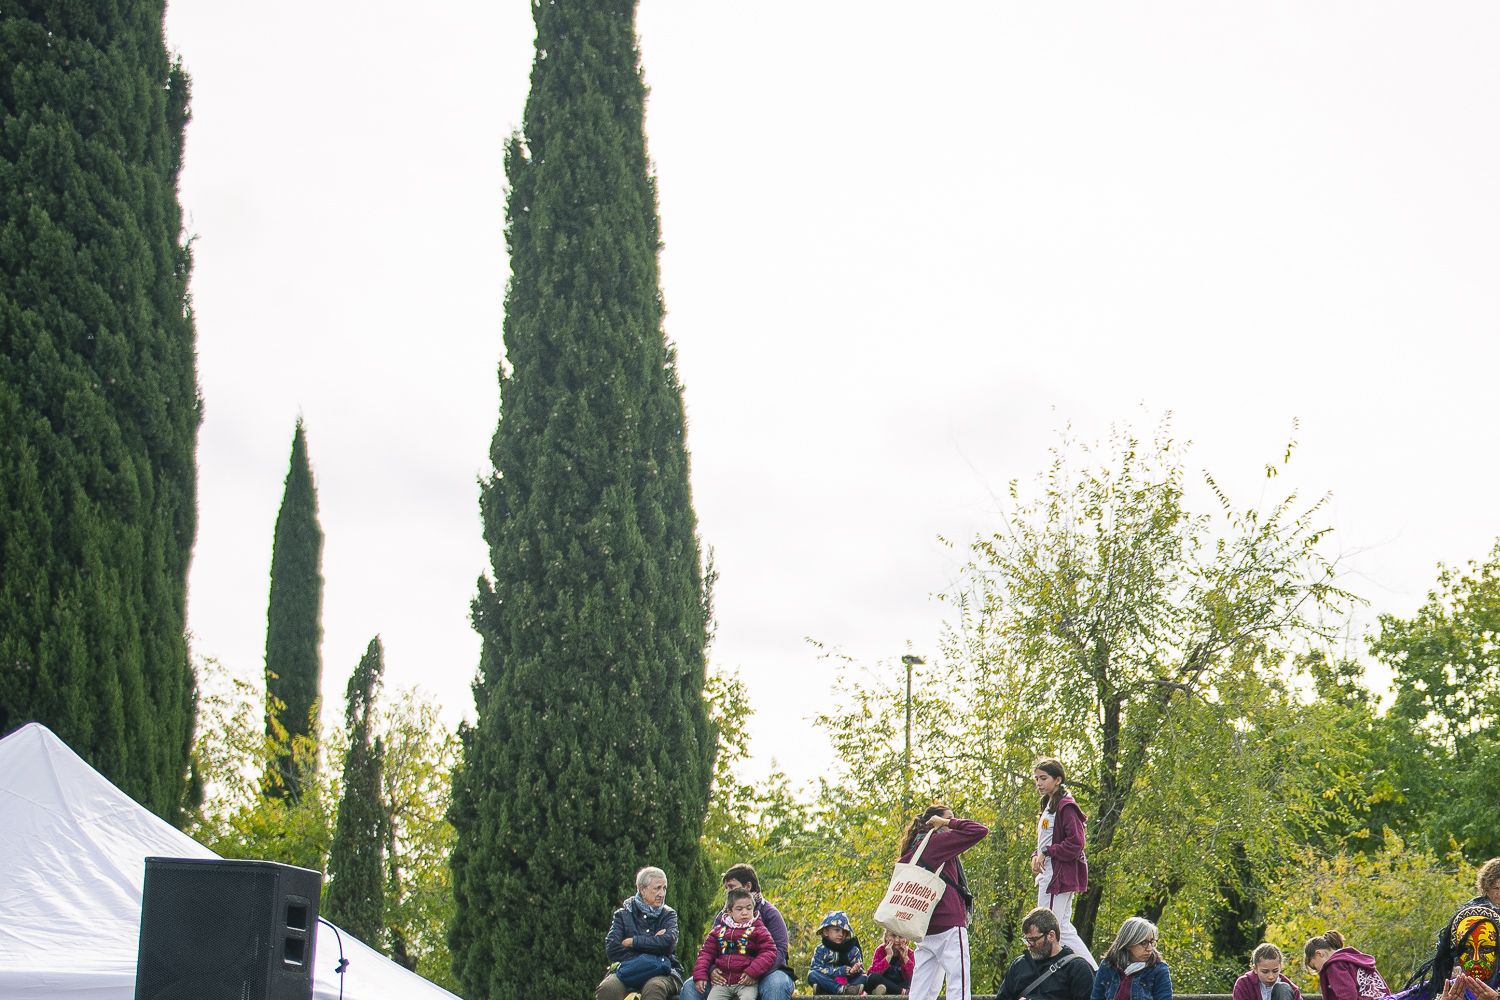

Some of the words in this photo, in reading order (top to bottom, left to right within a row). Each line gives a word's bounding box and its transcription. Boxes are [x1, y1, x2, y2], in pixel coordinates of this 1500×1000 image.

[901, 881, 932, 899] felicità
[890, 894, 902, 904] un
[901, 895, 929, 913] istante.
